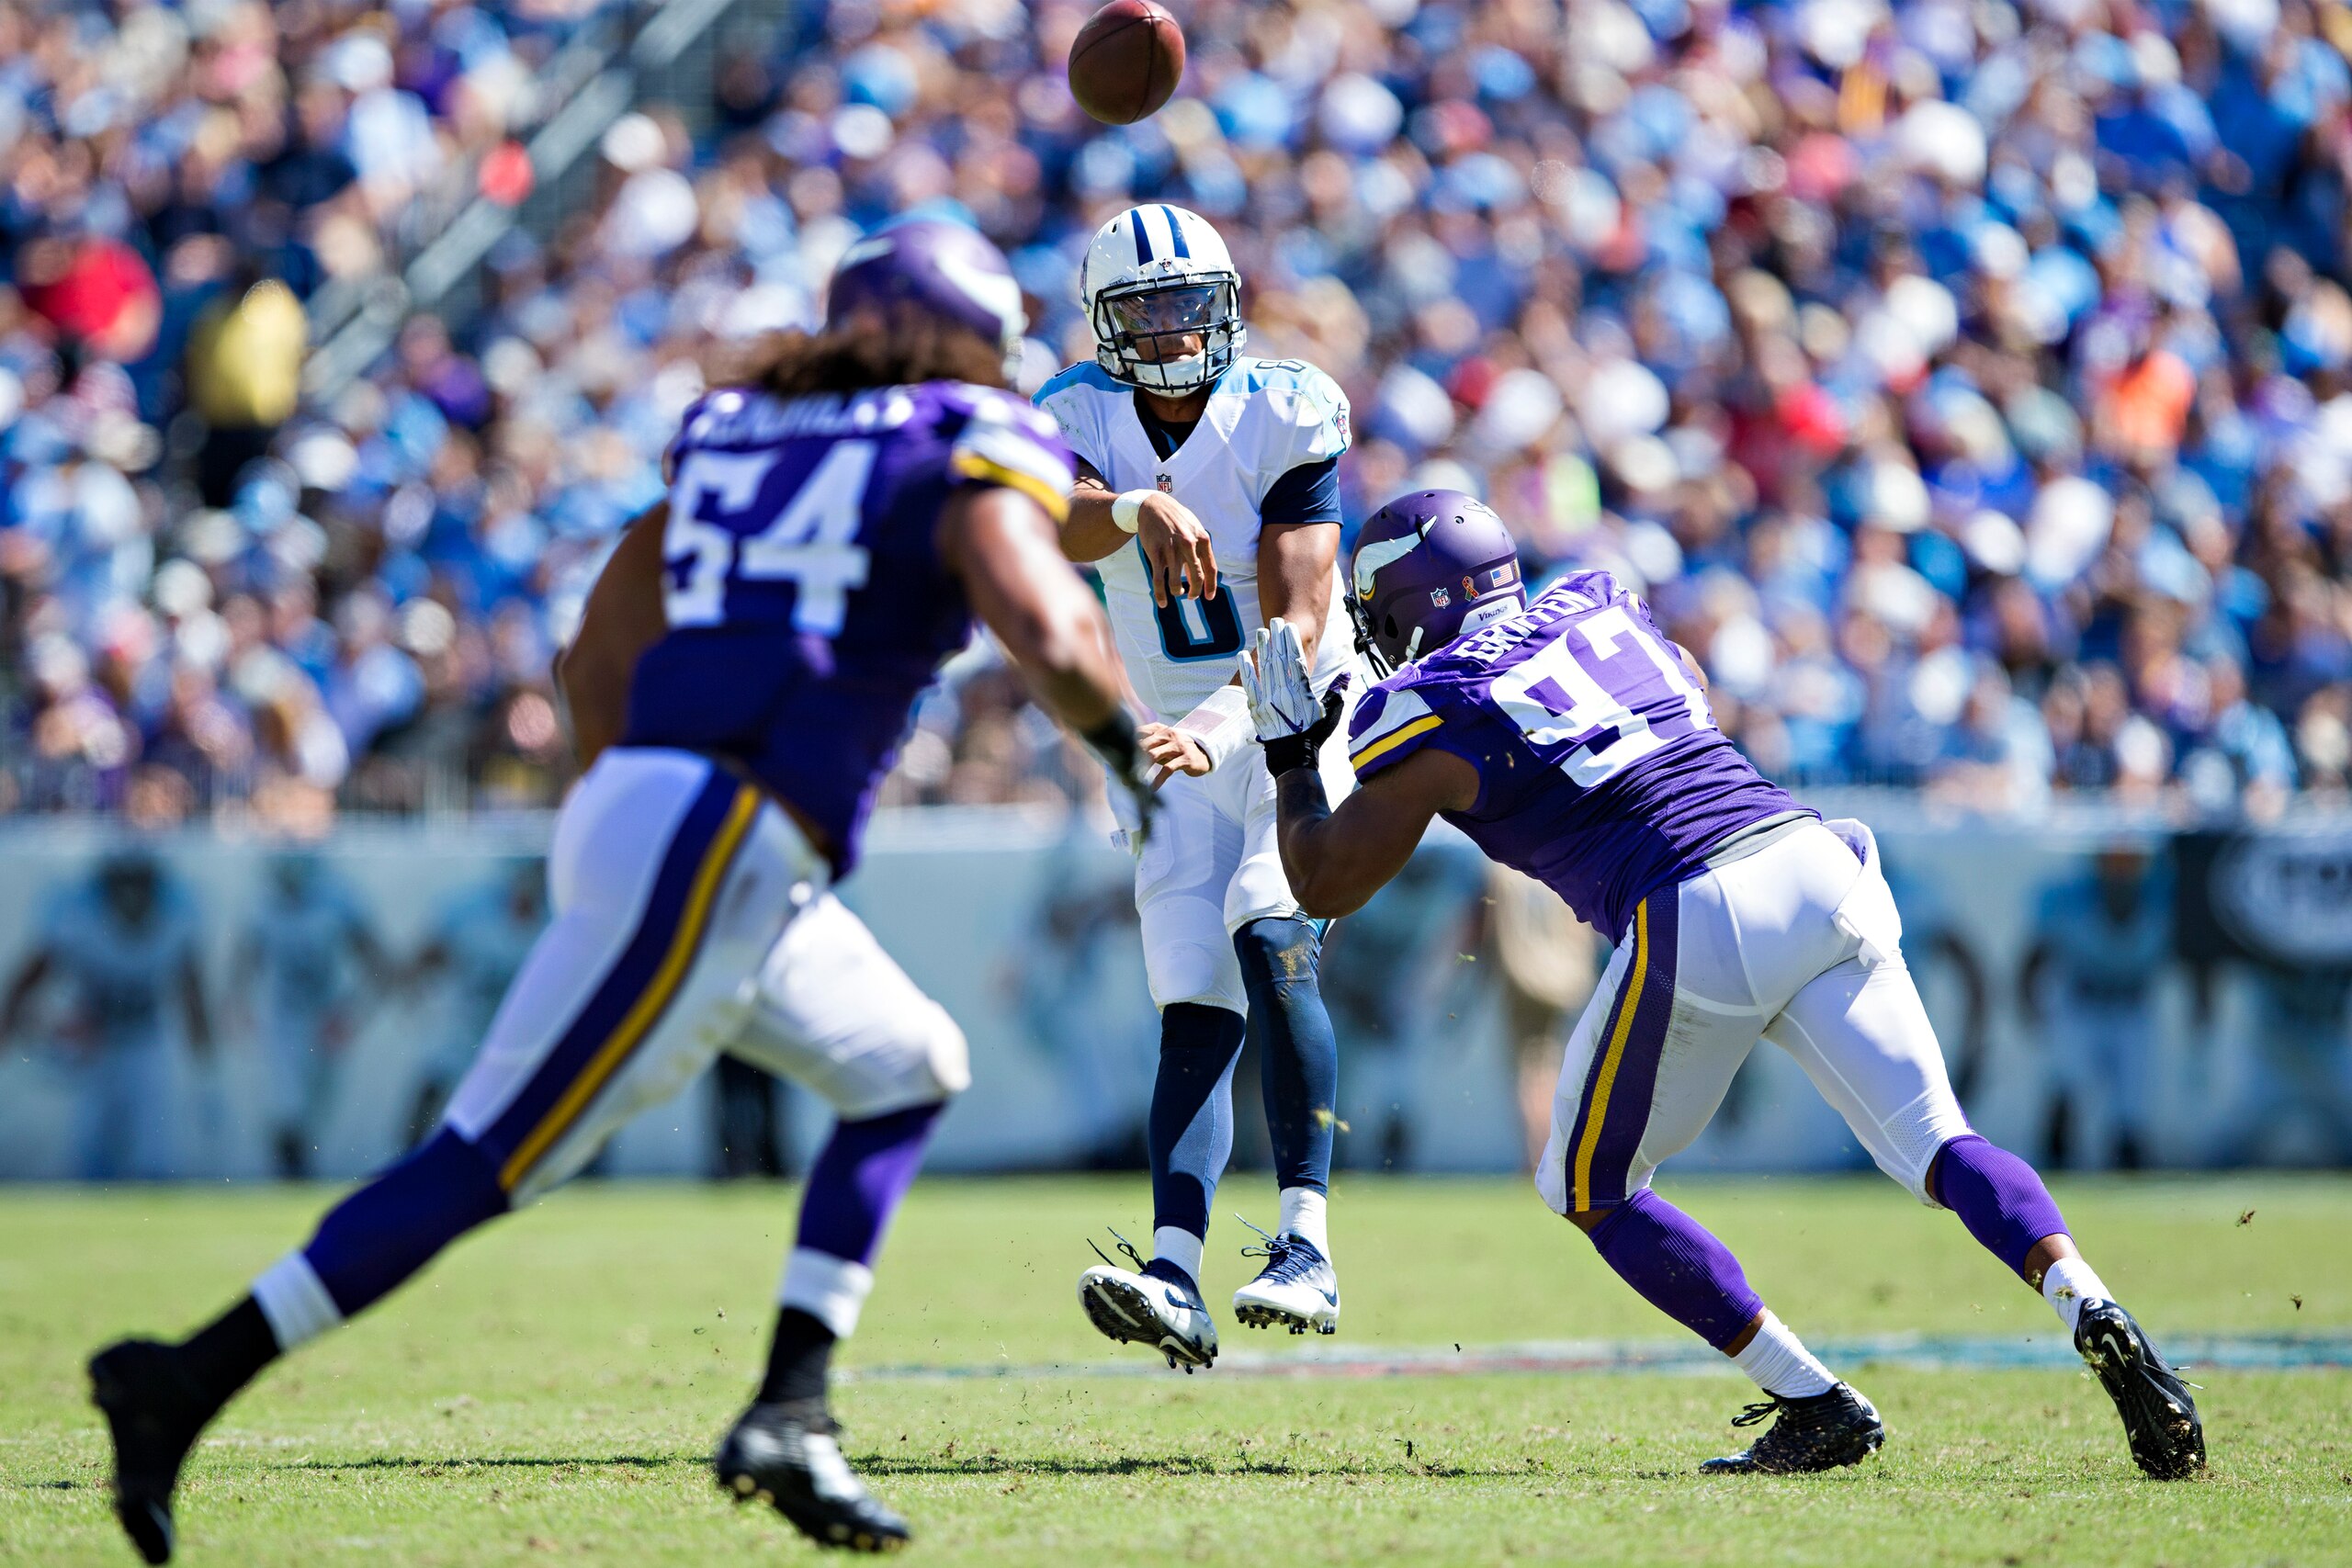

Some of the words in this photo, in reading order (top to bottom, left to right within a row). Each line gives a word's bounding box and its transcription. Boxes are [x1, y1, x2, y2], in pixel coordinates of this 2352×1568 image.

[1159, 482, 1171, 491] NFL
[661, 441, 879, 637] 54
[1435, 595, 1449, 606] NFL
[1490, 604, 1718, 788] 97
